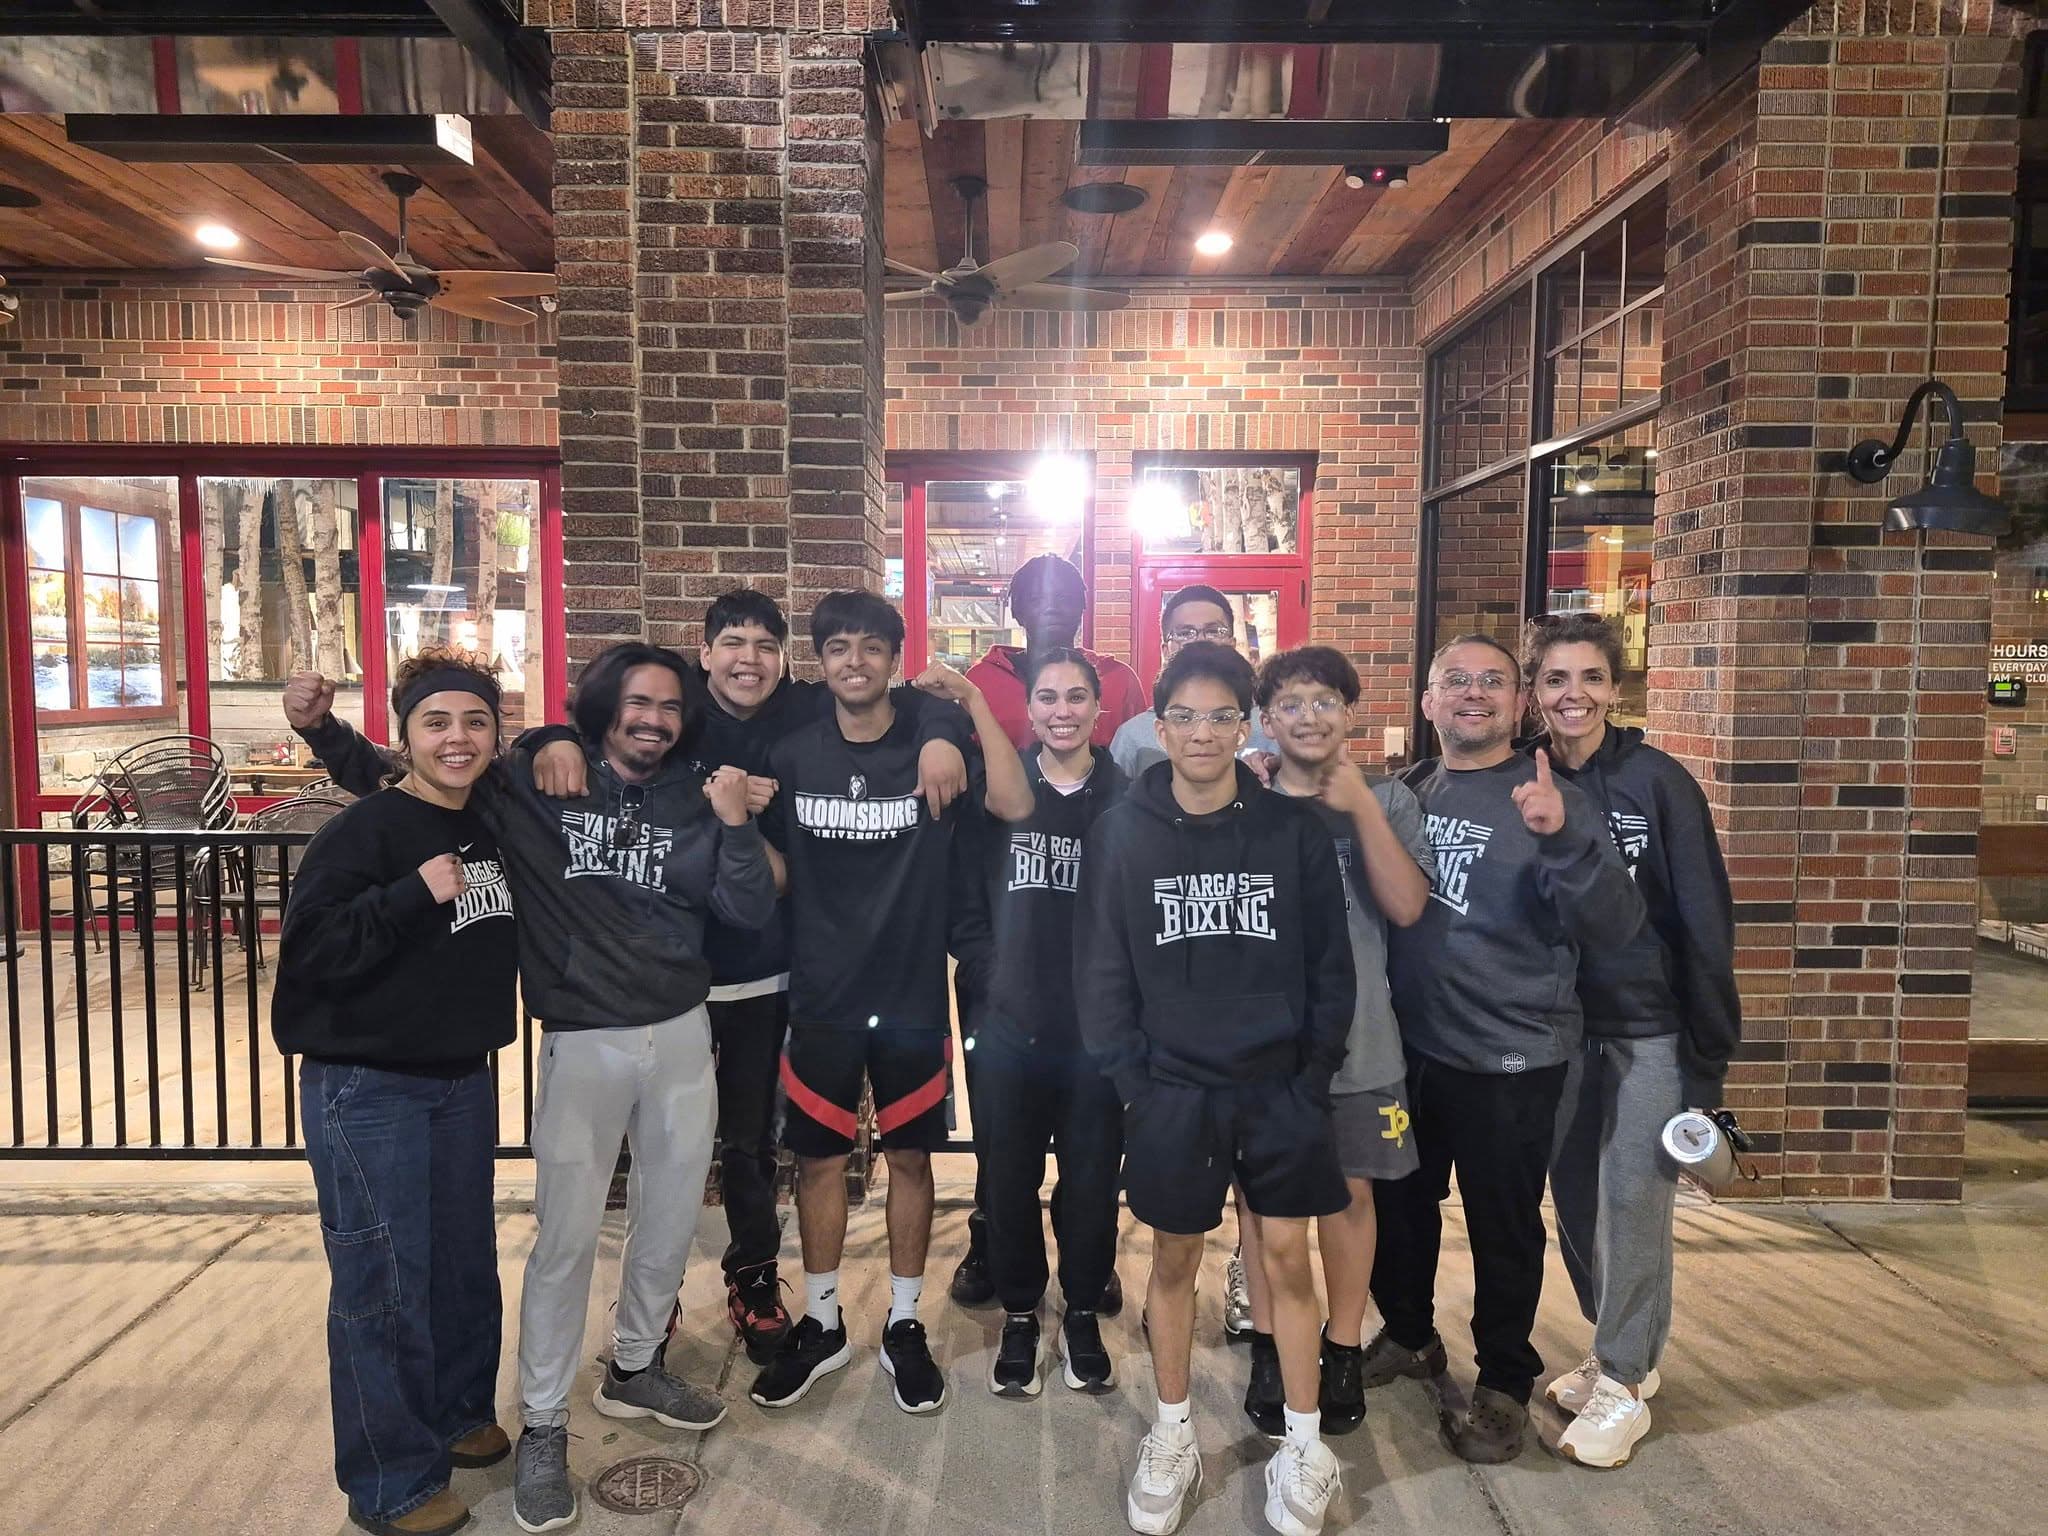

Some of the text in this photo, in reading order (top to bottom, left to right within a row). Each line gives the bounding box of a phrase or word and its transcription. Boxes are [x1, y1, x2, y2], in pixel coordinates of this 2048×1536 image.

[1993, 644, 2048, 658] HOURS
[1992, 662, 2047, 672] EVERYDAY
[2025, 673, 2048, 683] CLO
[795, 796, 918, 831] BLOOMSBURG
[812, 828, 898, 840] UNIVERSITY
[1424, 813, 1470, 845] RGAS
[1030, 832, 1082, 857] VARGA
[462, 859, 498, 883] ARGAS
[1176, 872, 1251, 898] VARGAS
[1161, 894, 1269, 938] BOXING
